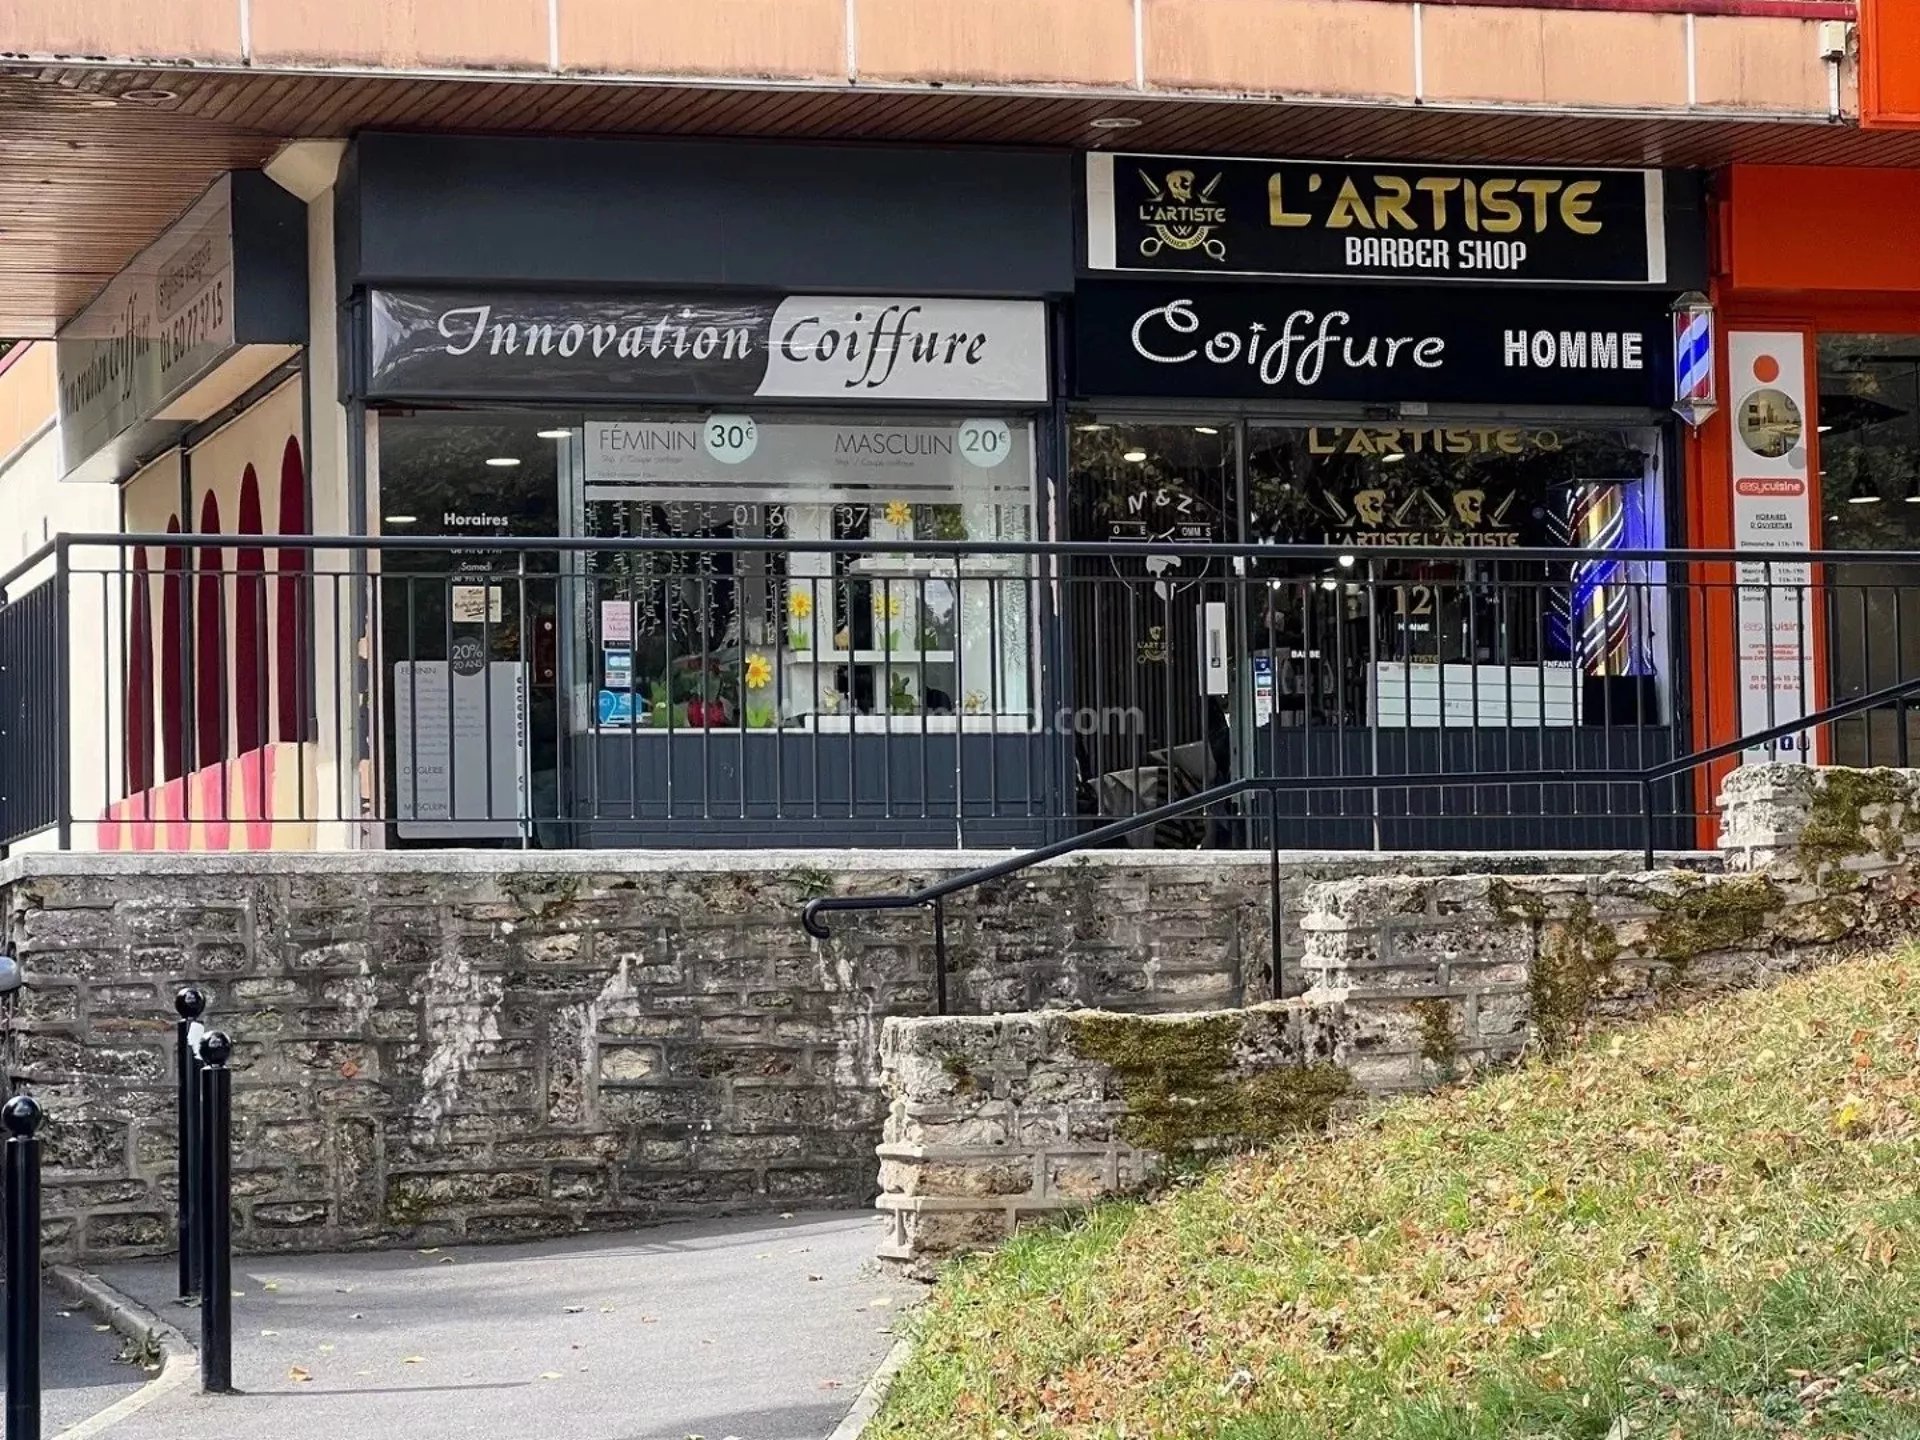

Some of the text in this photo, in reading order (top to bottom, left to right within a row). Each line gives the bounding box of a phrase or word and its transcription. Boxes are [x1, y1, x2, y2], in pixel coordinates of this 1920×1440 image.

[1139, 205, 1227, 222] L'ARTISTE
[1268, 172, 1603, 234] L'ARTISTE
[1346, 236, 1527, 270] BARBER SHOP
[160, 327, 171, 373] 01
[173, 315, 185, 363] 60
[212, 280, 224, 330] 15
[438, 304, 987, 388] Innovation Coiffure
[1131, 299, 1643, 386] Coiffure HOMME
[600, 424, 754, 450] FÉMININ 30€
[834, 429, 1007, 455] MASCULIN 20€
[1309, 427, 1523, 453] L'ARTISTE
[1740, 481, 1800, 494] easycuisine
[443, 512, 509, 526] Horaires
[734, 505, 757, 525] 01
[843, 507, 869, 527] 37
[460, 561, 493, 572] Samedi
[1393, 584, 1433, 615] 12
[1398, 622, 1430, 631] HMME
